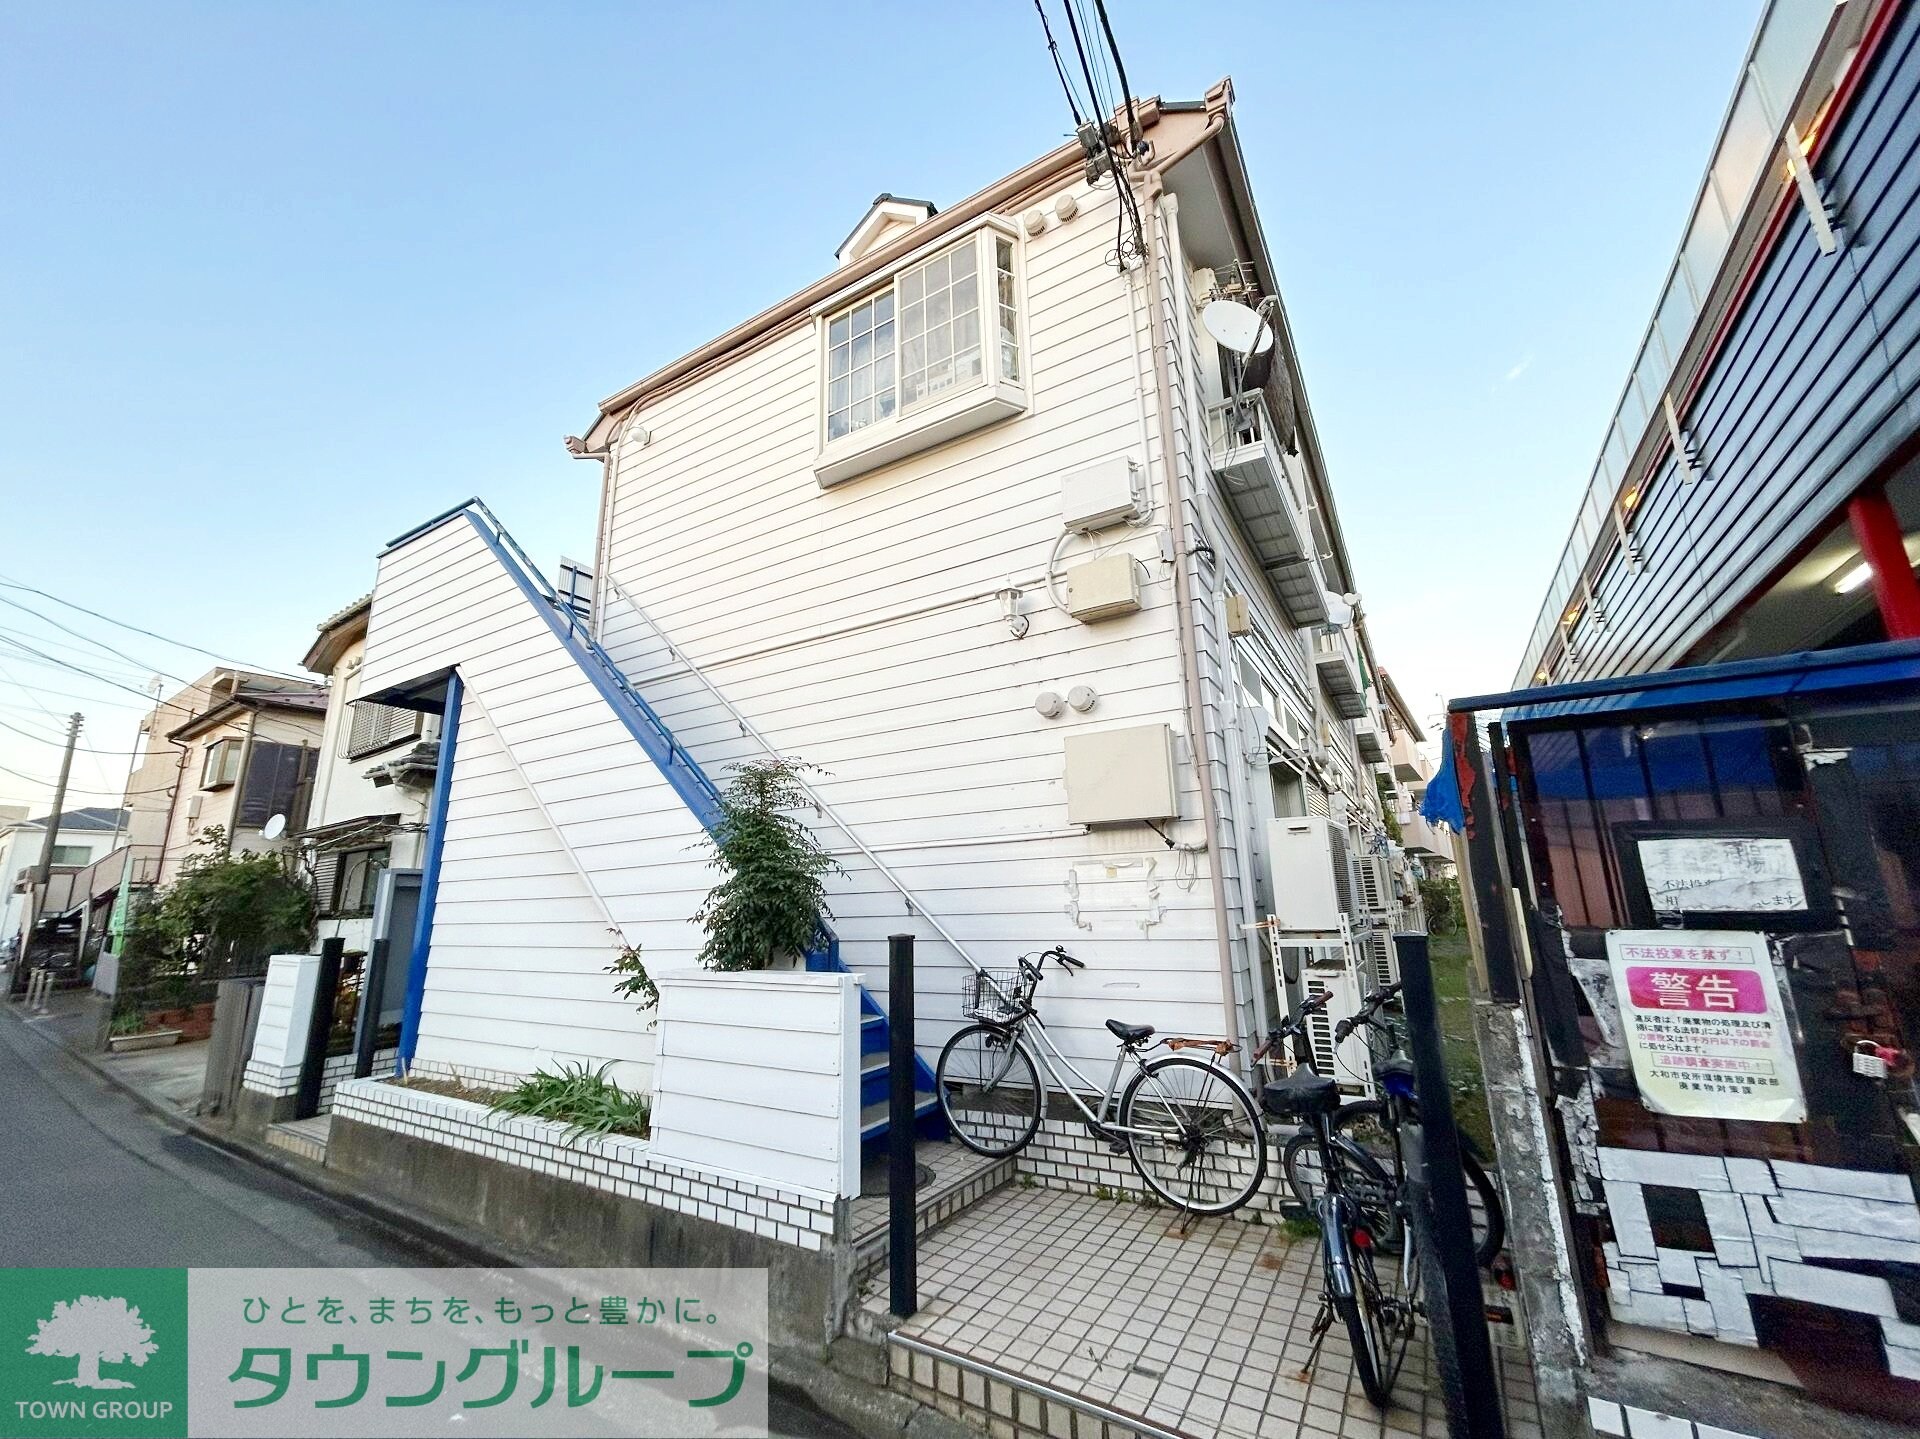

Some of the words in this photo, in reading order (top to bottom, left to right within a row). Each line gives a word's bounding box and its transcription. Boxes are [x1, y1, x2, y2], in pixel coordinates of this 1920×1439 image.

[1649, 972, 1739, 1009] 警告
[1639, 1042, 1707, 1054] に処せられます。
[1679, 1081, 1753, 1095] 廃棄物対策課
